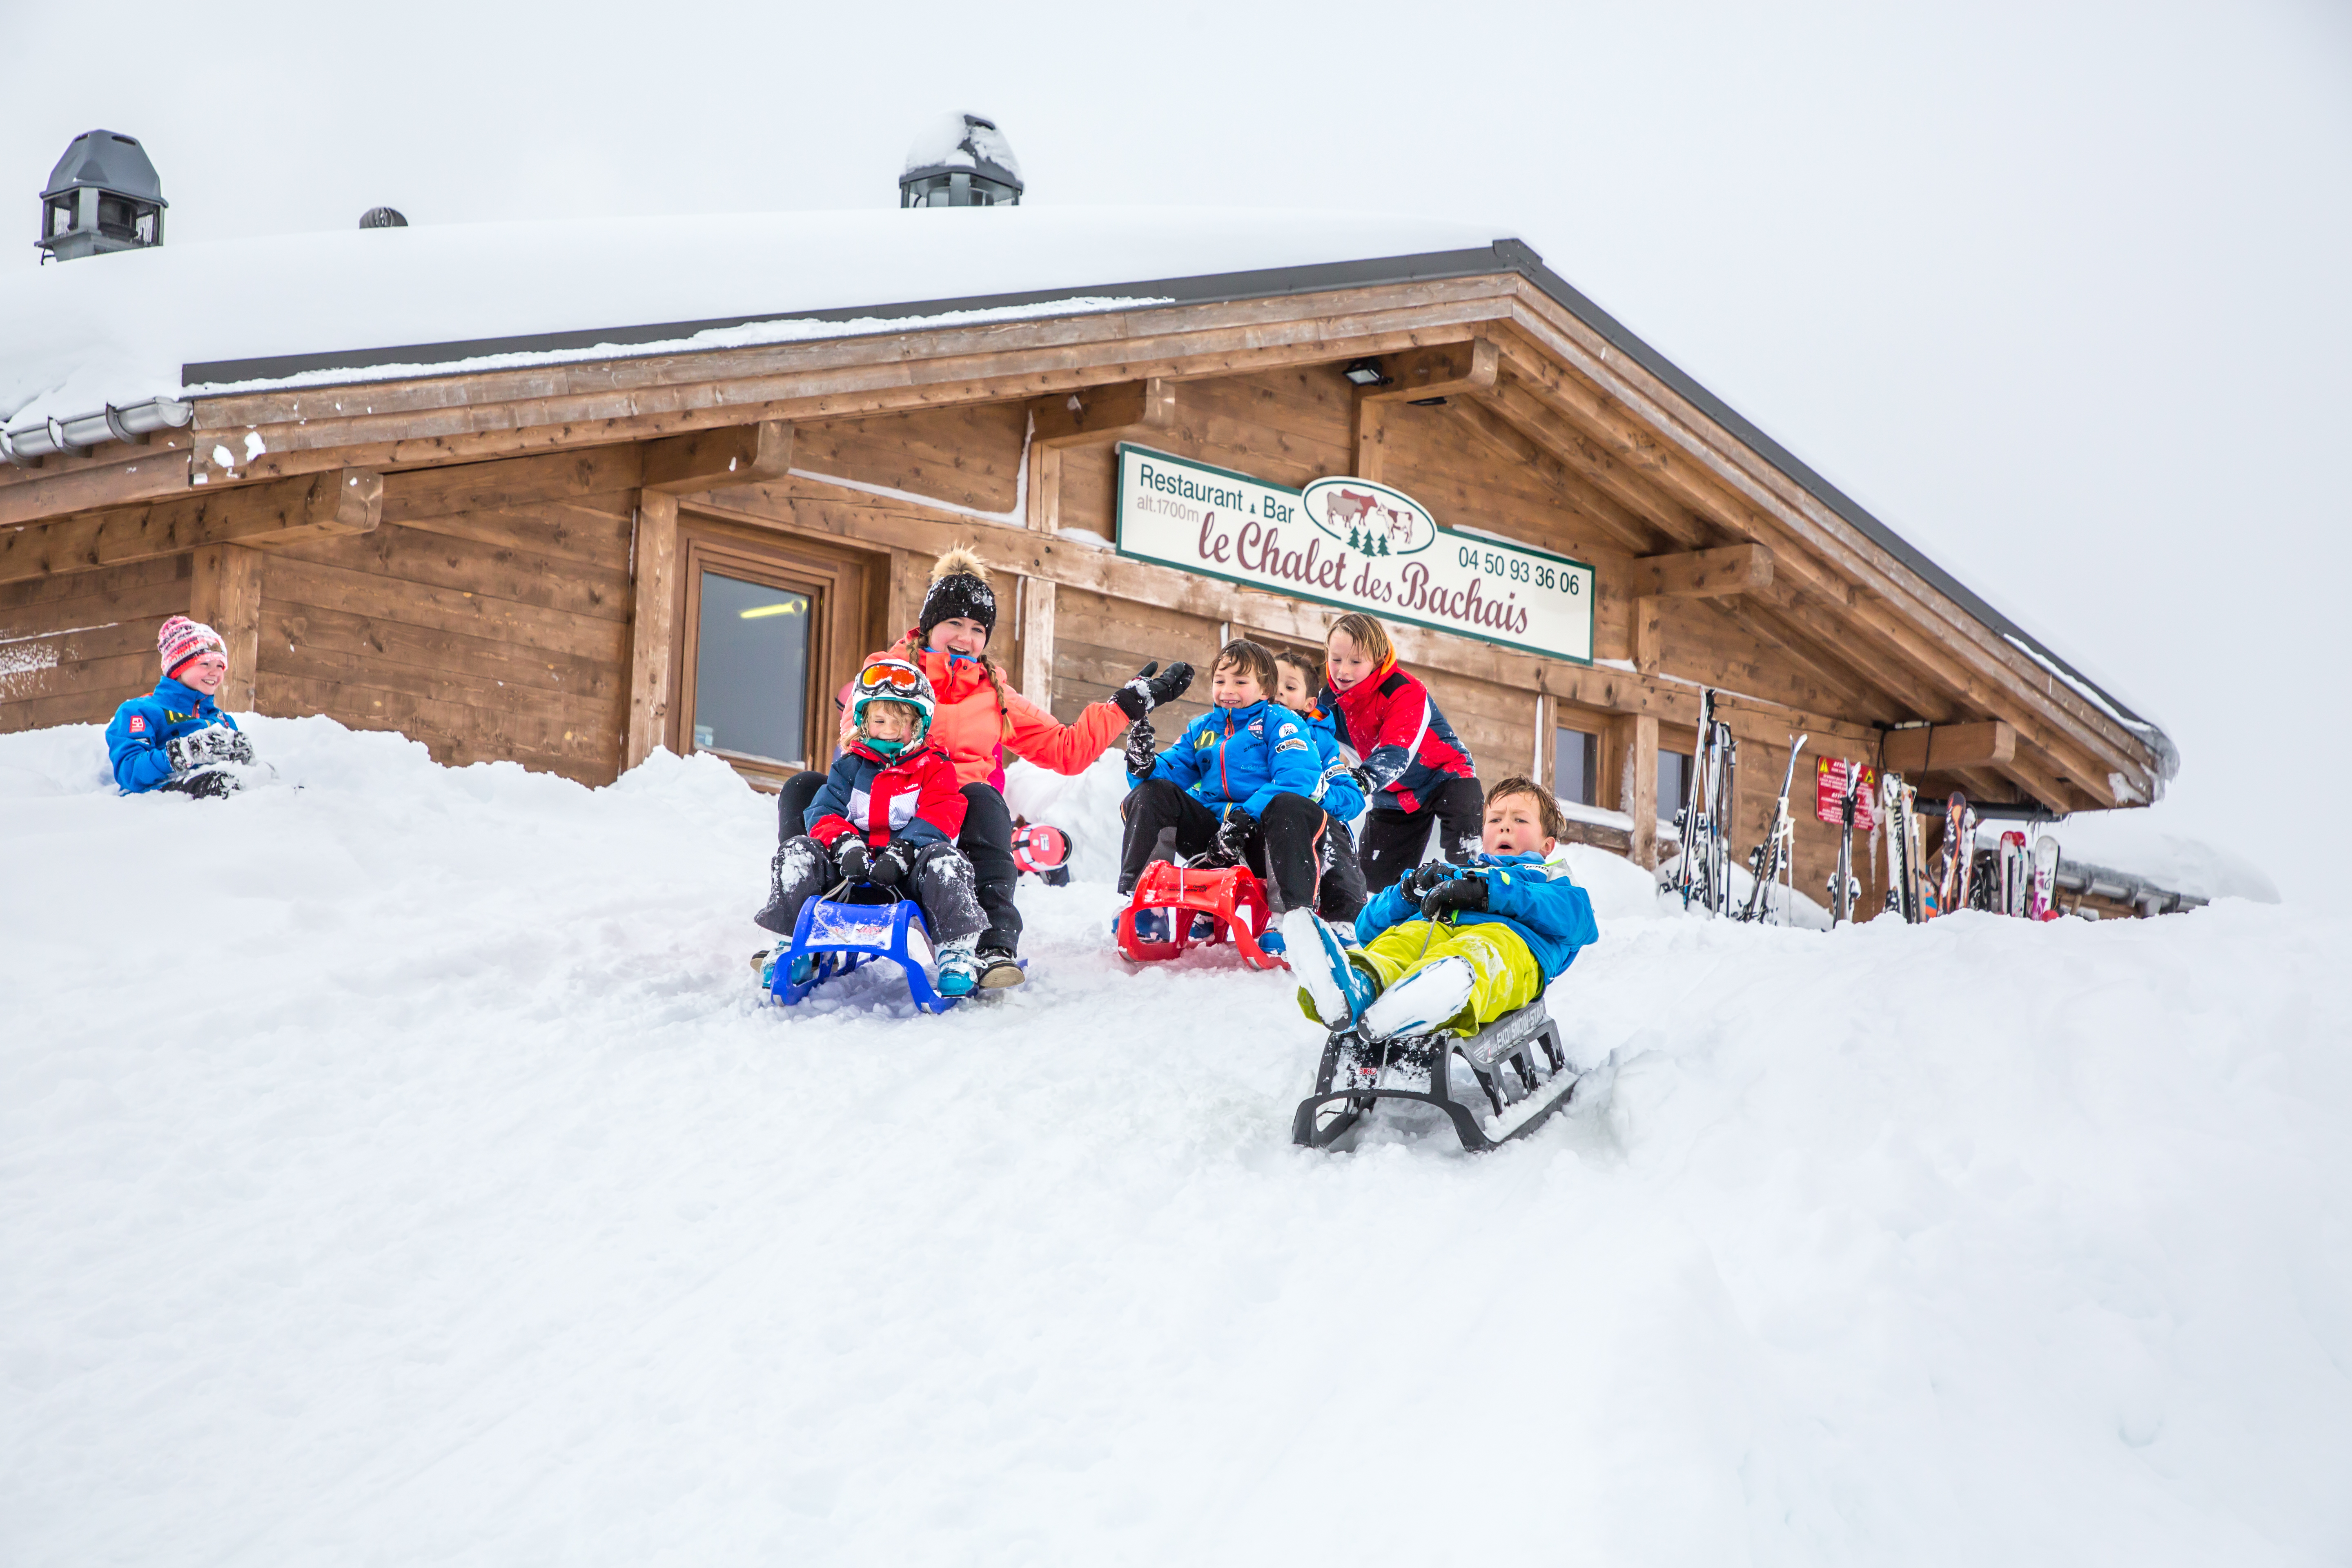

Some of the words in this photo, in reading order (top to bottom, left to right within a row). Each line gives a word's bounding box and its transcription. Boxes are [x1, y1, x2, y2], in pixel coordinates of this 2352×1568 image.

[1140, 463, 1243, 511] Restaurant
[1263, 495, 1294, 523] Bar
[1198, 511, 1230, 563] le
[1237, 521, 1347, 591] Chalet
[1353, 562, 1392, 603] des
[1397, 561, 1528, 634] Bachais
[1459, 546, 1479, 570] 04
[1485, 552, 1504, 577] 50
[1510, 559, 1530, 583] 93
[1535, 566, 1555, 589] 36
[1560, 572, 1579, 595] 06
